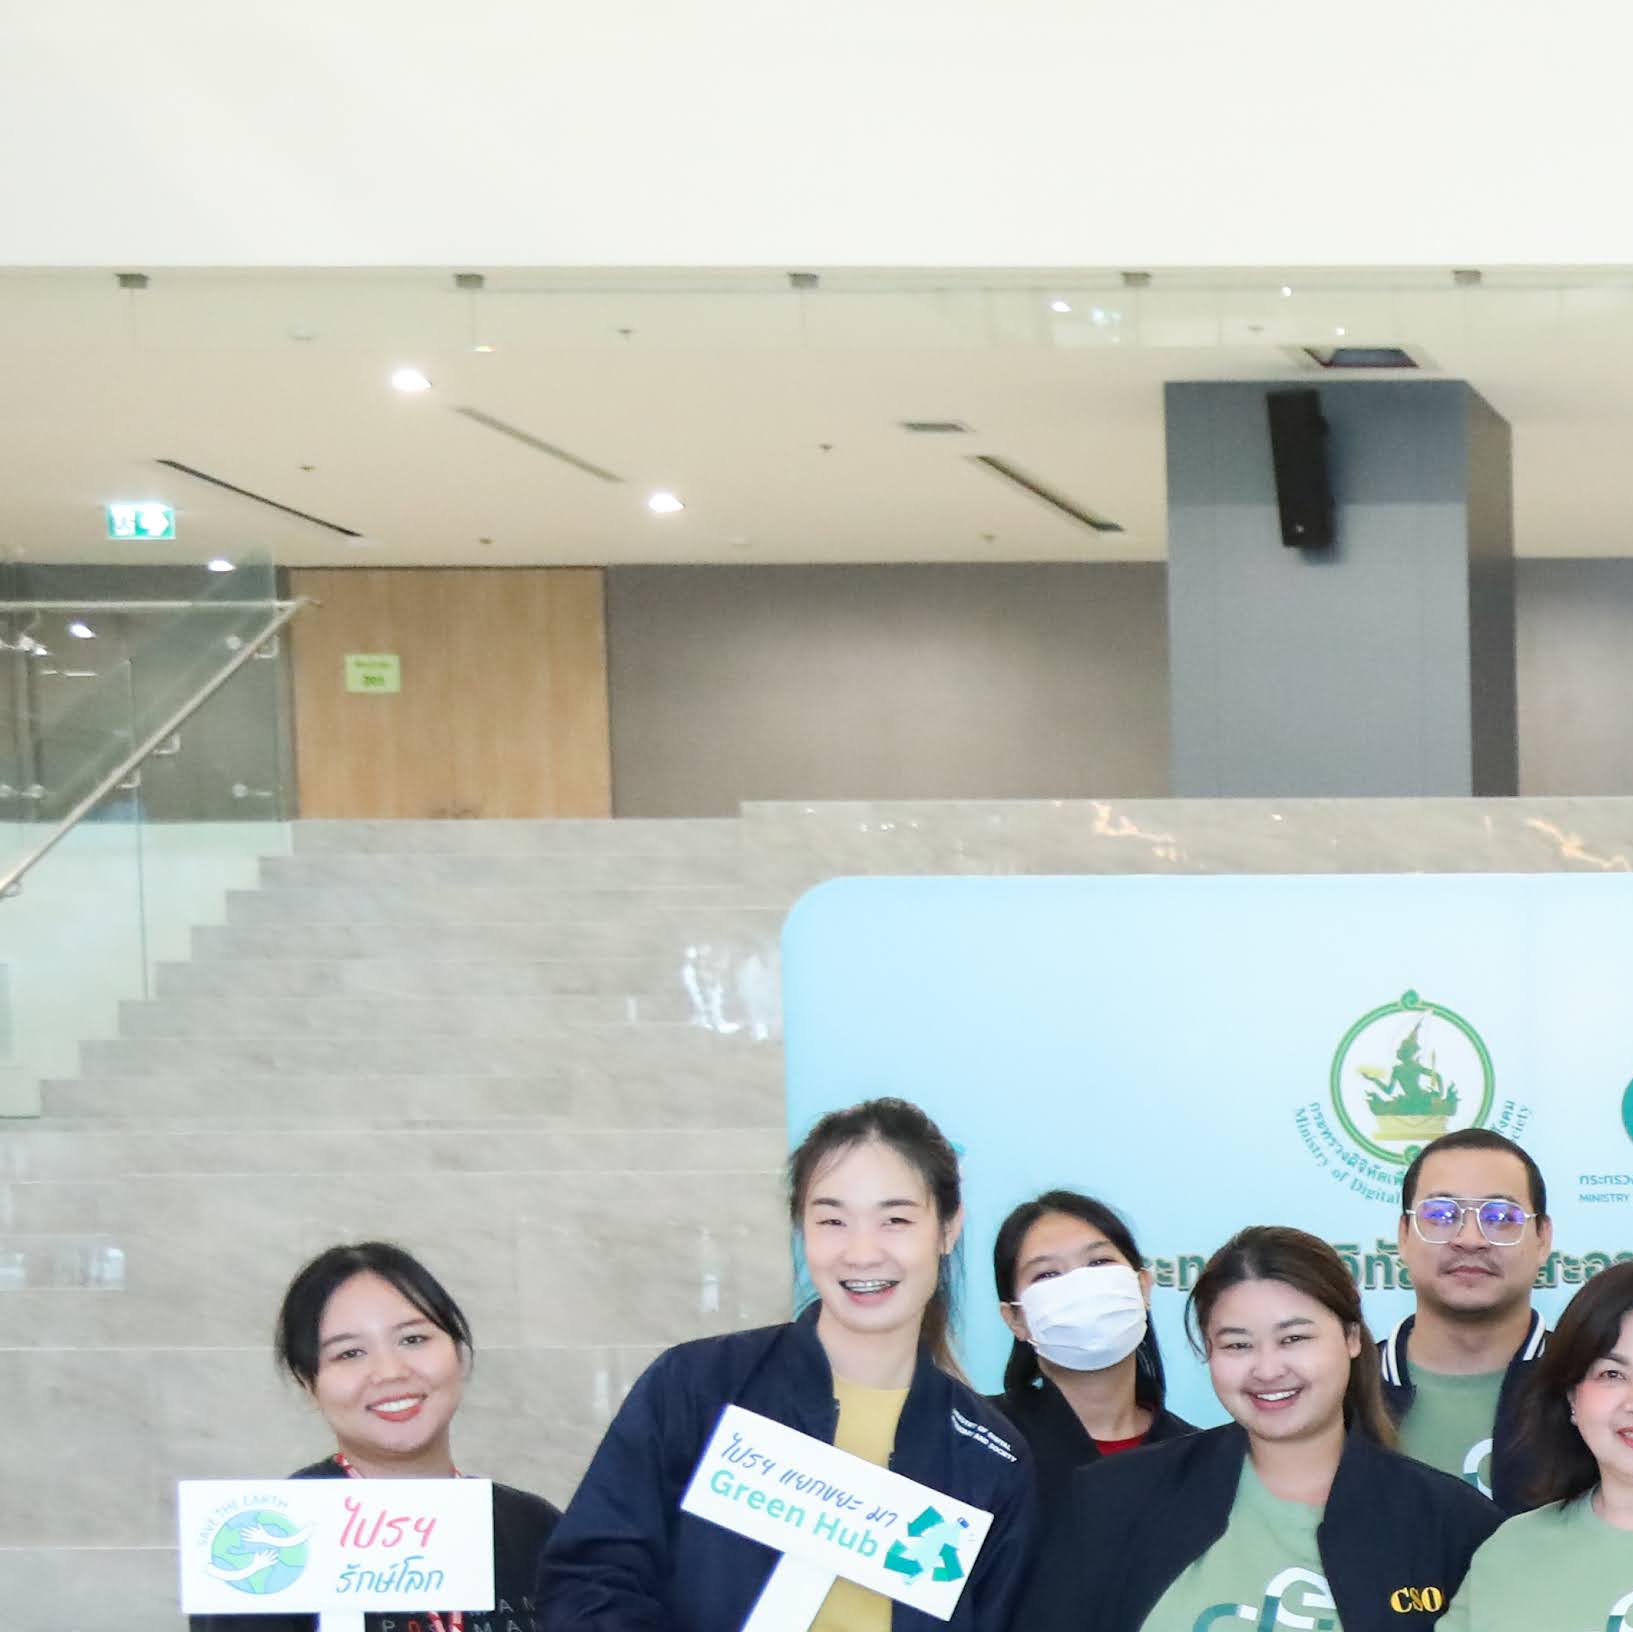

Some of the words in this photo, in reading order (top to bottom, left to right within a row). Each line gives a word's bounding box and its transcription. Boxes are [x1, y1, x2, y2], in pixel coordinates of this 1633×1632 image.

[1331, 1168, 1350, 1182] of
[1579, 1193, 1629, 1203] MINISTRY
[709, 1469, 806, 1529] Green
[812, 1511, 879, 1558] Hub
[1391, 1587, 1443, 1613] CSO
